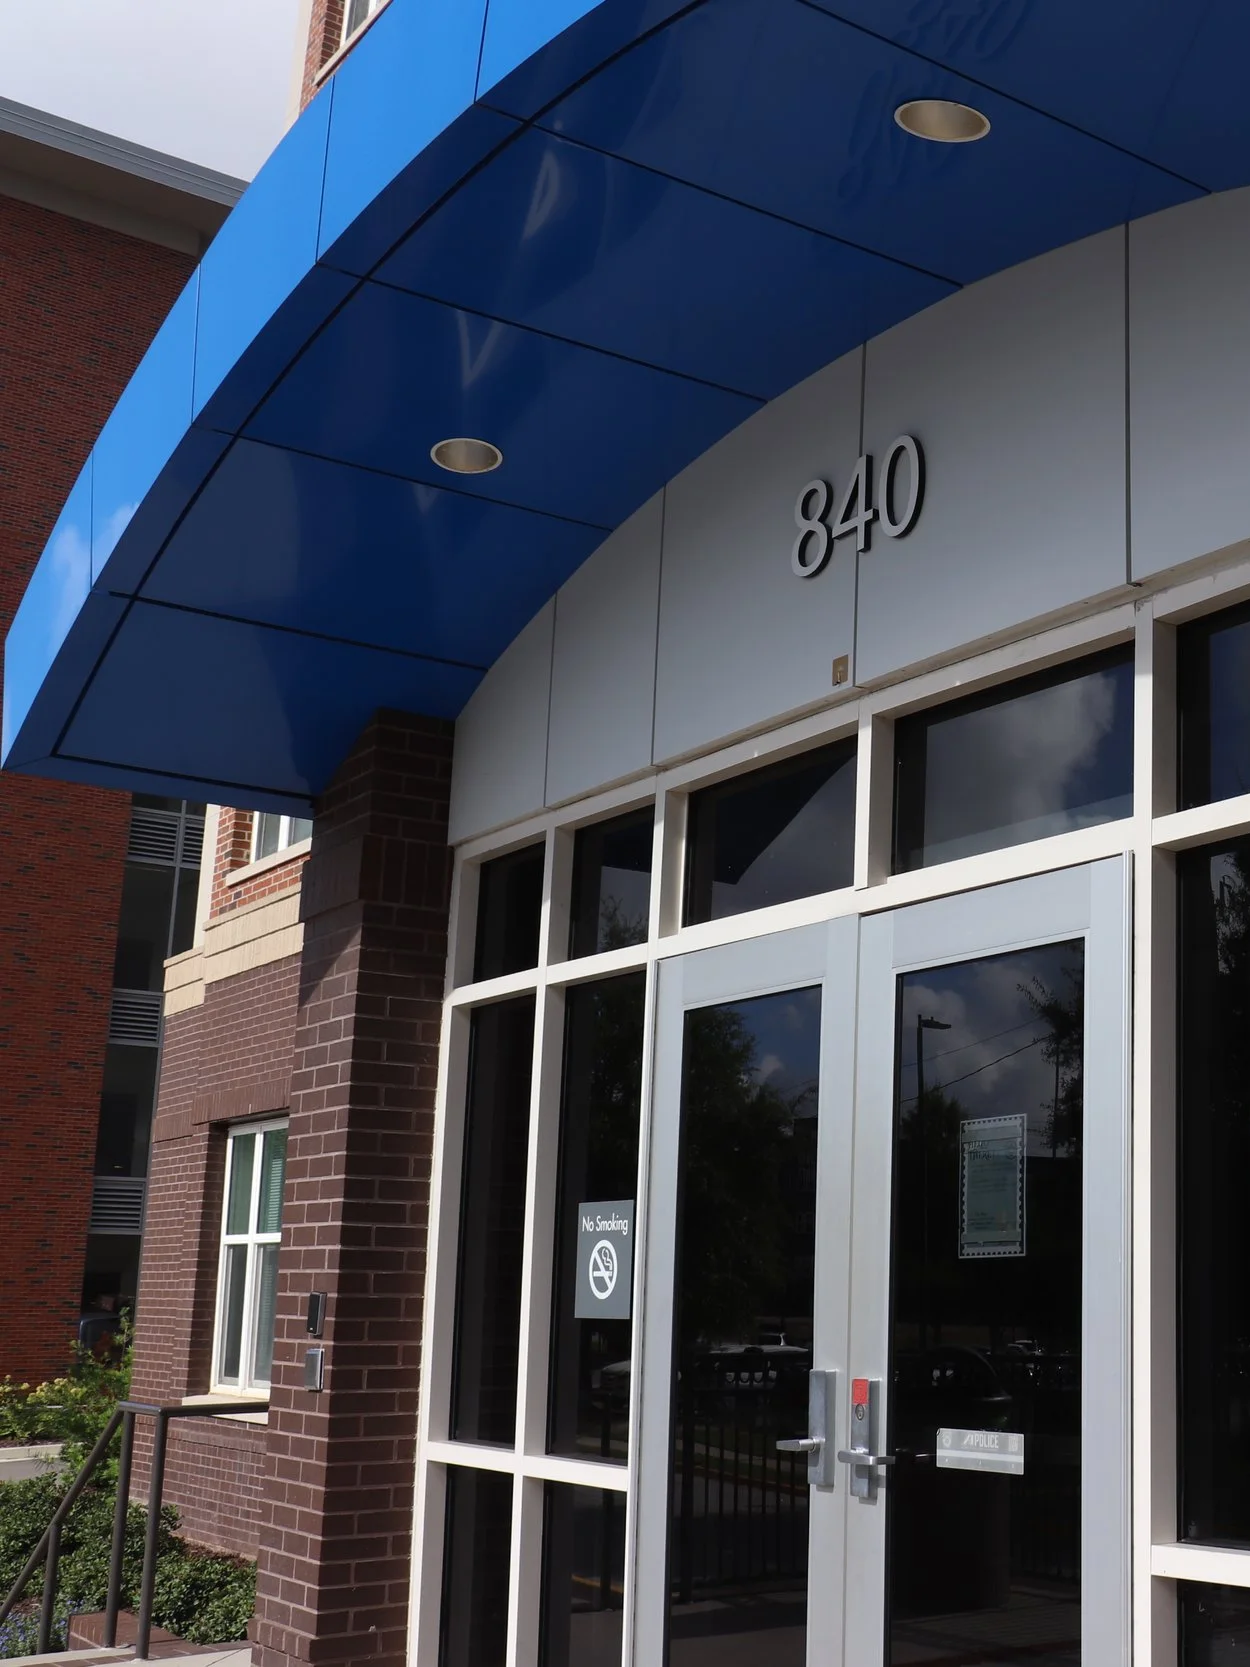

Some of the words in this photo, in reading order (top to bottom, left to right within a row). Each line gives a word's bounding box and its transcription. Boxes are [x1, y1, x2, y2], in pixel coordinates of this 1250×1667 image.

[791, 434, 926, 578] 840
[581, 1216, 595, 1232] No
[595, 1213, 629, 1235] Smoking
[974, 1433, 999, 1449] POLICE
